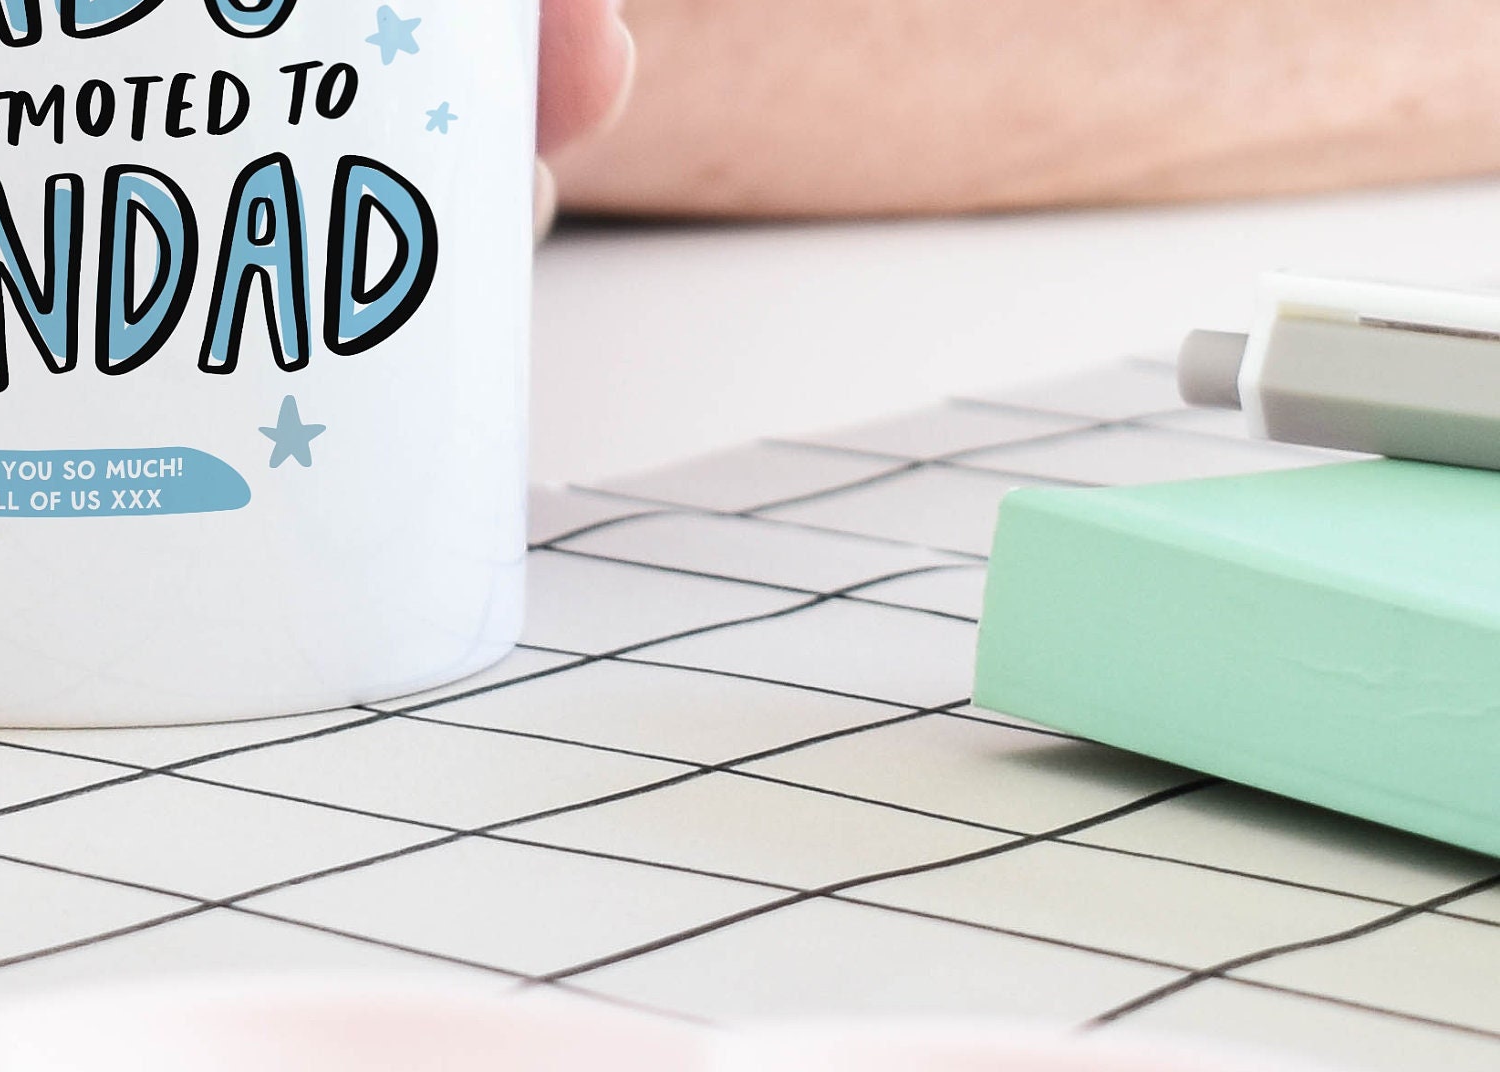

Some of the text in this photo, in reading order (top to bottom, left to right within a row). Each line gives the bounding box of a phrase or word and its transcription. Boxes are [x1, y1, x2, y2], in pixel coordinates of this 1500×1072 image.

[279, 61, 359, 126] TO
[2, 461, 52, 480] YOU
[62, 460, 96, 480] SO
[105, 457, 183, 479] MUCH!
[30, 491, 61, 511] OF
[70, 489, 101, 510] US
[111, 489, 161, 509] XXX
